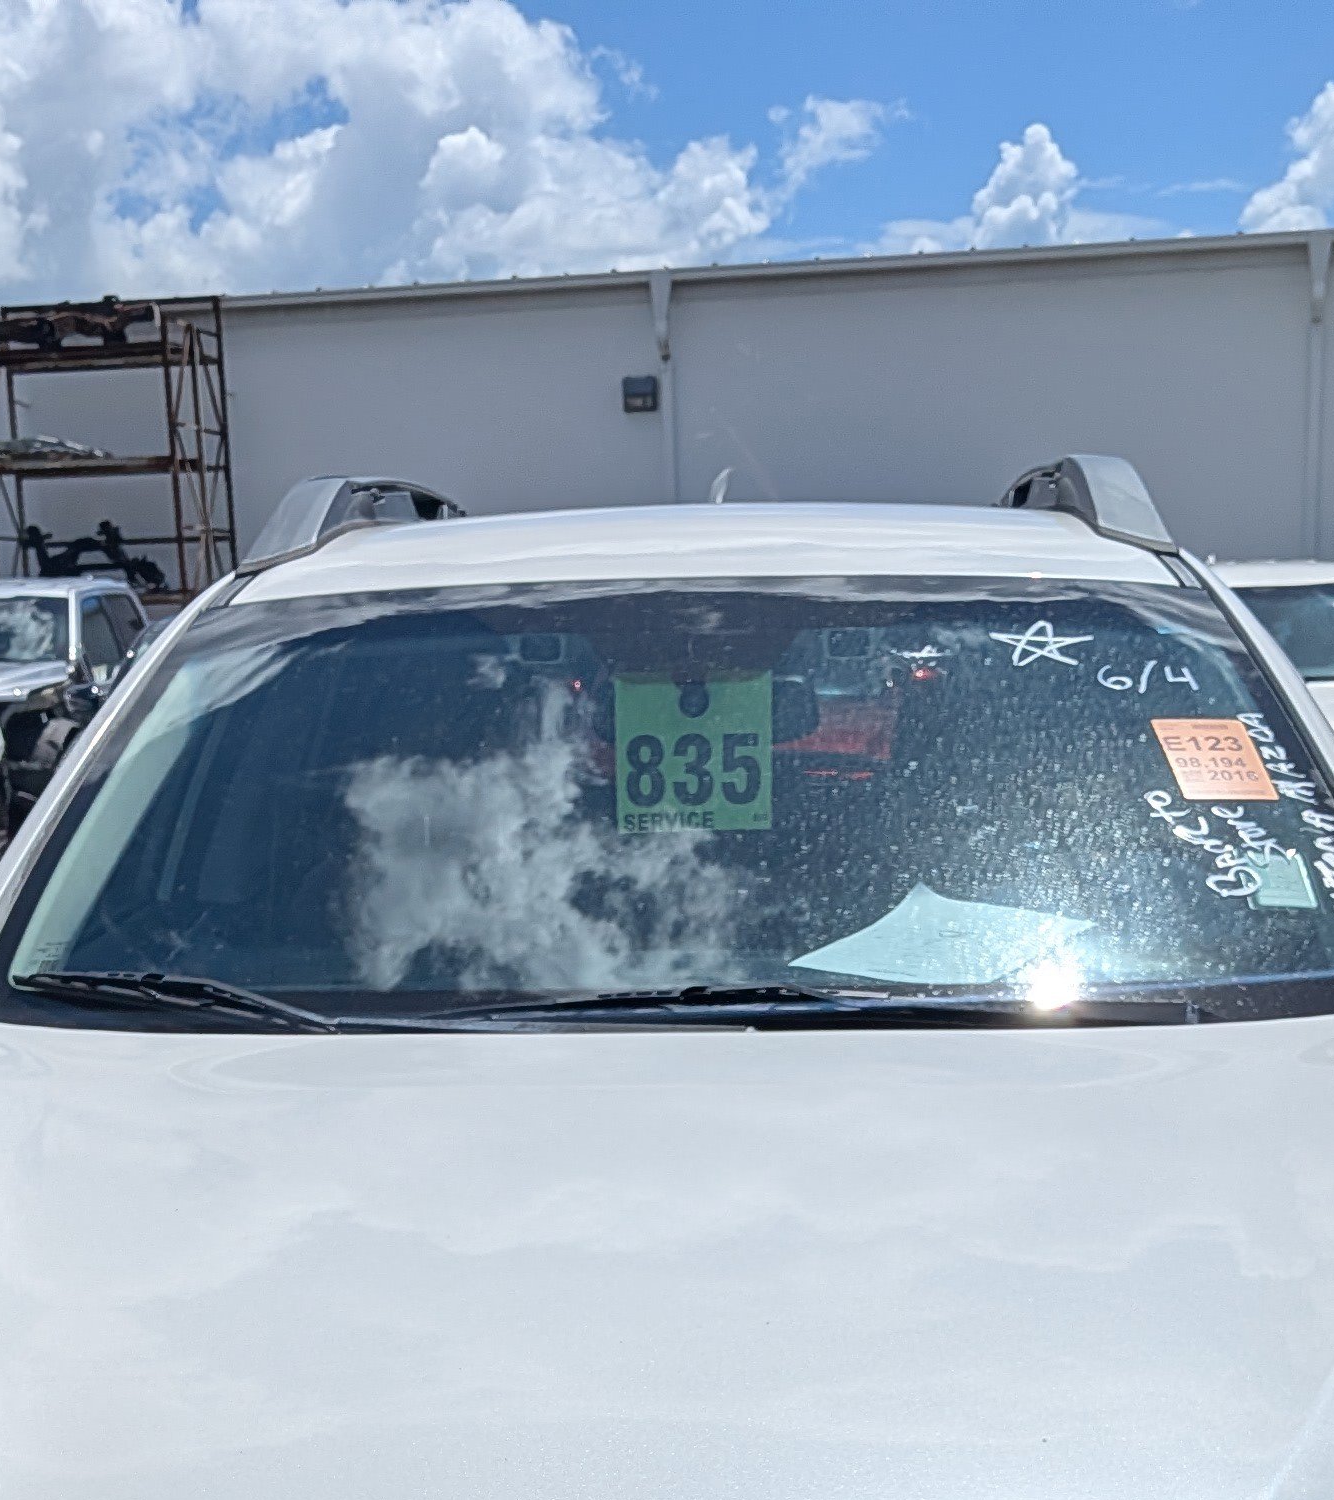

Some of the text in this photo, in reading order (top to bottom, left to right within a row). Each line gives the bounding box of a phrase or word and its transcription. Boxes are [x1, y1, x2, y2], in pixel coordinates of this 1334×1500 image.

[1096, 660, 1199, 695] 6/4
[1163, 735, 1243, 752] E123
[1236, 711, 1318, 805] MAZDA
[626, 733, 761, 808] 835
[623, 811, 715, 832] SERVICE
